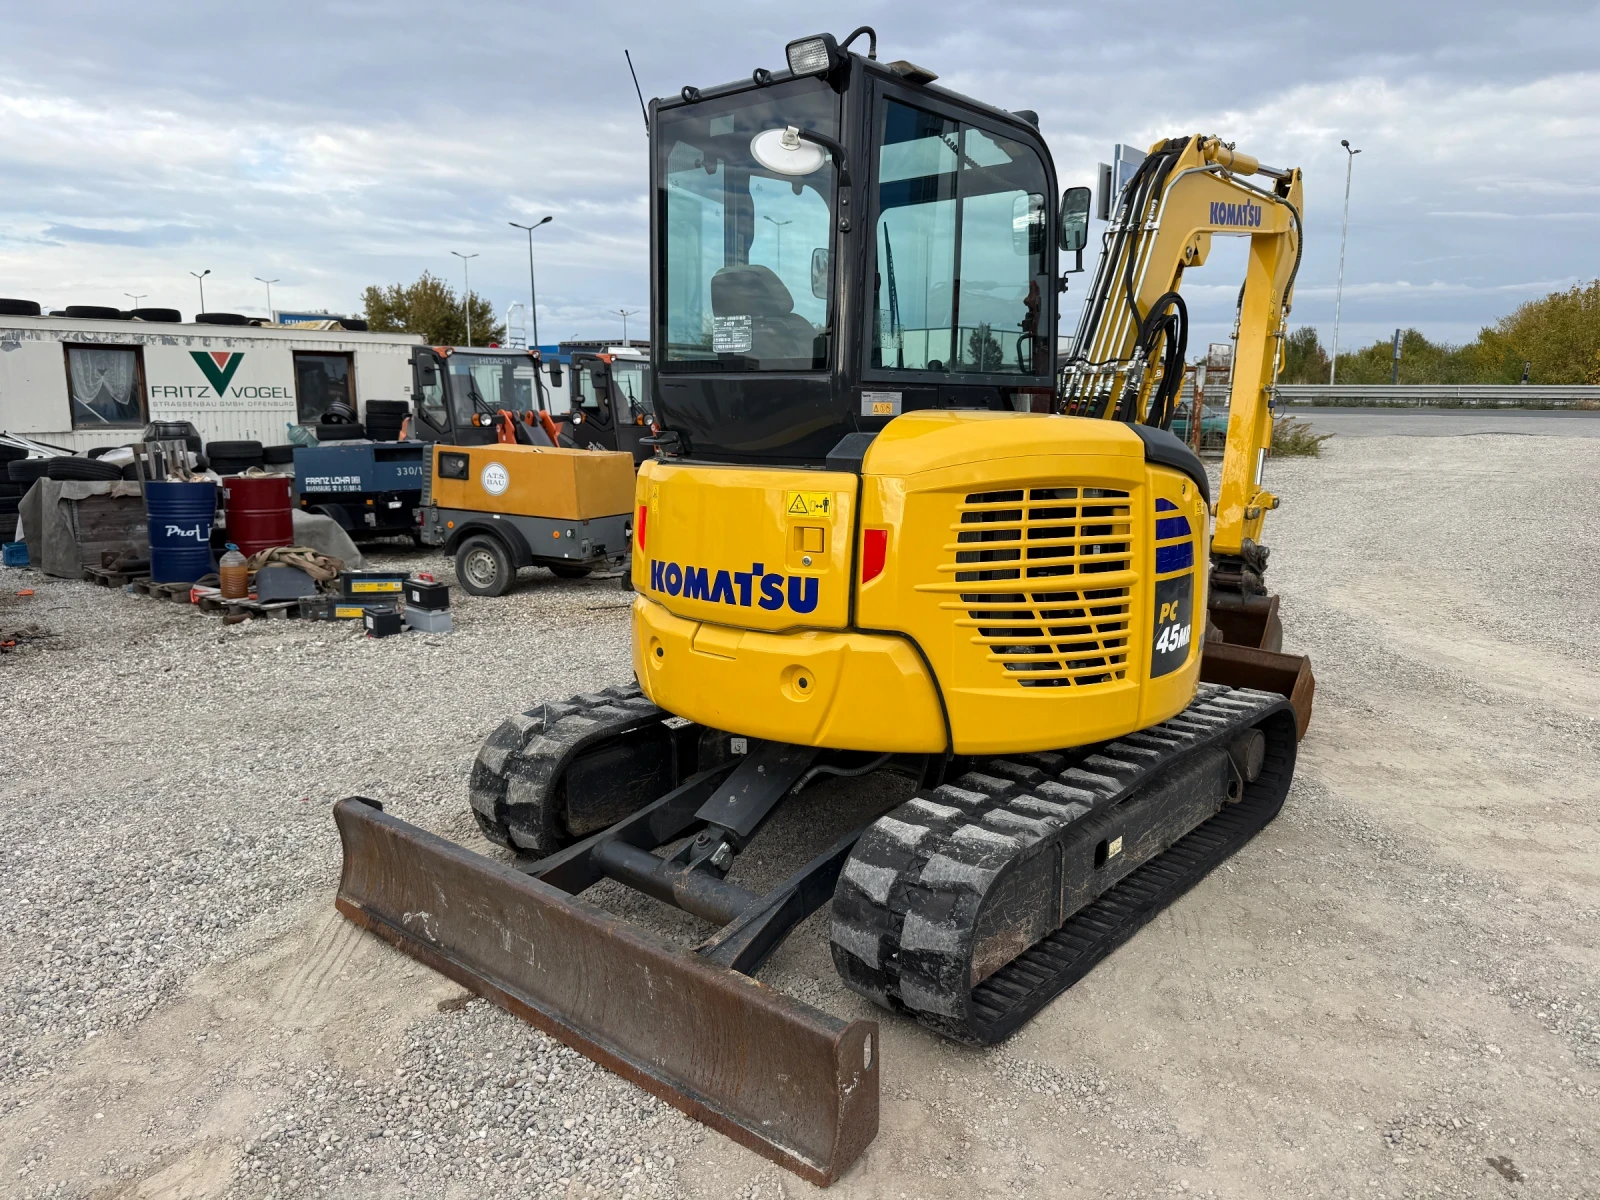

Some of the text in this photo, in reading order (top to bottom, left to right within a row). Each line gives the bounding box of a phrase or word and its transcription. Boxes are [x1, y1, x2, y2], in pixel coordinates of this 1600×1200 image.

[1209, 198, 1262, 227] KOMATSU
[479, 357, 512, 365] HITACHI
[151, 386, 293, 399] FRITZ VOGEL
[305, 476, 330, 485] FRANZ
[330, 476, 351, 485] LOHR
[165, 524, 212, 541] ProLi
[651, 559, 819, 614] KOMATSU
[1158, 600, 1179, 625] PC
